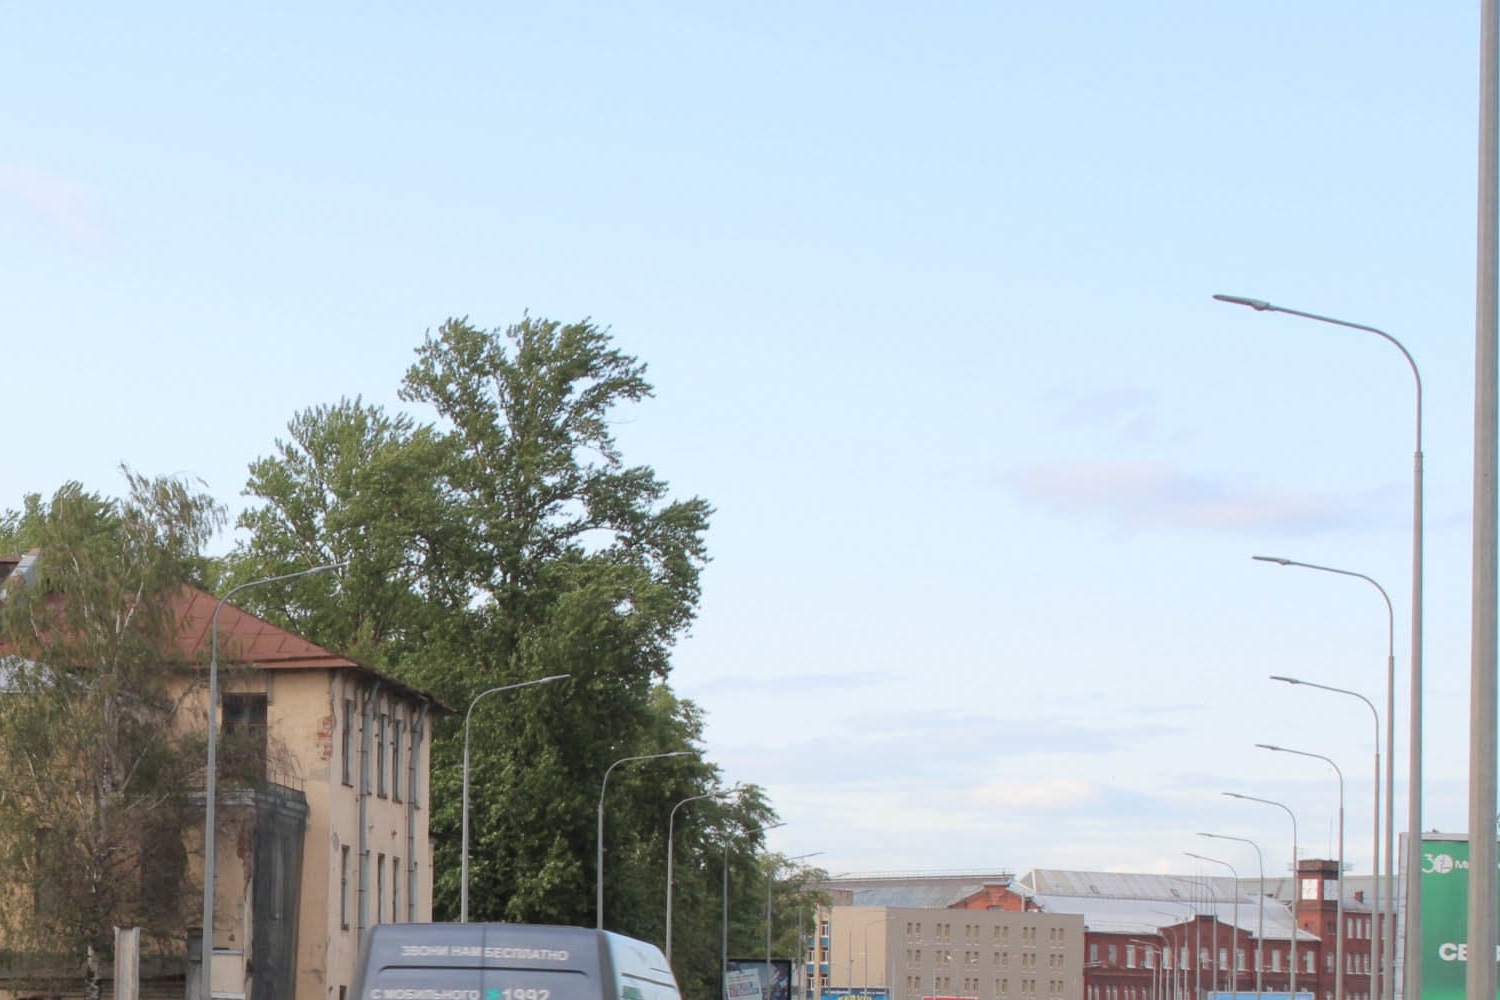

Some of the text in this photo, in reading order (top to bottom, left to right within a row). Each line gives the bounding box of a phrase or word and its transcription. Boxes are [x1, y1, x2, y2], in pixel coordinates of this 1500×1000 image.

[401, 945, 569, 961] ЗВОНИ НАМ БЕСПЛАТНО
[370, 988, 480, 1000] С МОБИЛЬНОГО
